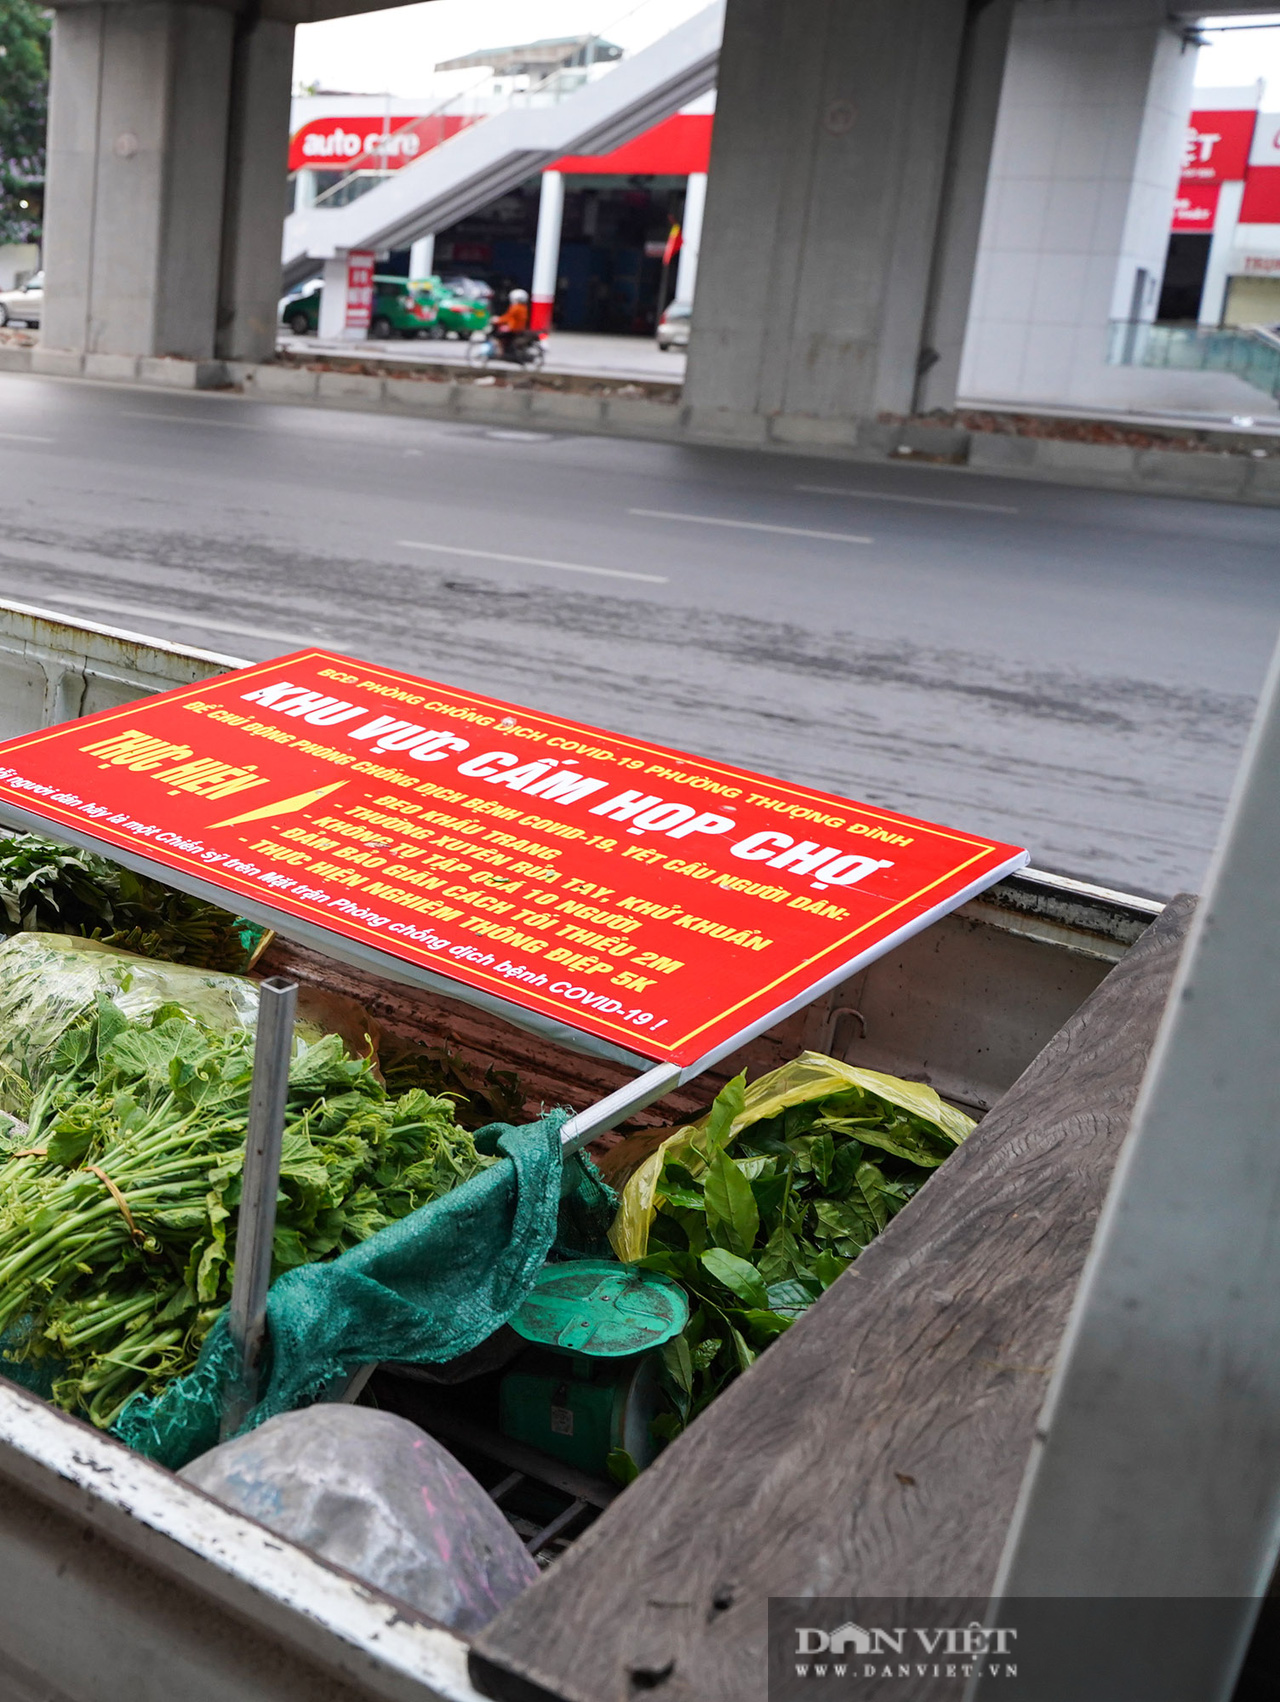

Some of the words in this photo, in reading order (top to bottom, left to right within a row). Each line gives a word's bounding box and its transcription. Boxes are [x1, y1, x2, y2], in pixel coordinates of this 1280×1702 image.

[302, 127, 362, 157] auto
[363, 132, 420, 157] care
[77, 729, 194, 772] THỰC
[149, 756, 271, 801] HIỆN
[181, 700, 225, 714] ĐỂ
[206, 709, 256, 727] CHỦ
[239, 721, 297, 745] ĐỘNG
[287, 739, 357, 766] PHÒNG
[350, 760, 421, 788] CHỐNG
[412, 782, 469, 804] DỊCH
[460, 797, 525, 821] BỆNH
[517, 815, 618, 853] COVID-19,
[620, 845, 669, 865] YÊT
[662, 859, 717, 880] CẦU
[710, 873, 792, 903] NGƯỜI
[786, 895, 851, 921] DÂN:
[239, 681, 389, 726] KHU
[347, 714, 471, 762] VỰC
[456, 751, 610, 806] CẤM
[588, 789, 737, 839] HỌP
[729, 830, 895, 891] CHỢ
[316, 668, 360, 684] BCĐ
[355, 680, 426, 706] PHÒNG
[423, 701, 497, 727] CHỐNG
[492, 720, 549, 742] DỊCH
[545, 736, 645, 770] COVID-19
[643, 764, 743, 799] PHƯỜNG
[744, 792, 847, 829] THƯỢNG
[846, 823, 915, 847] ĐÌNH
[372, 795, 424, 815] ĐEO
[416, 810, 487, 835] KHẨU
[481, 829, 563, 861] TRANG
[4, 776, 61, 796] người
[49, 793, 84, 807] dân
[77, 802, 113, 818] hãy
[105, 813, 131, 825] là
[121, 820, 163, 837] một
[154, 832, 205, 855] Chiến
[200, 848, 231, 863] sỹ
[221, 858, 262, 877] trên
[256, 871, 299, 890] Mặt
[290, 884, 331, 904] trận
[326, 897, 392, 927] Phòng
[388, 922, 452, 951] chống
[448, 945, 496, 966] dịch
[492, 959, 549, 987] bệnh
[548, 981, 654, 1025] COVID-19
[247, 838, 313, 866] THỰC
[303, 860, 371, 890] HIỆN
[360, 881, 465, 922] NGHIÊM
[458, 915, 550, 954] THÔNG
[542, 947, 614, 975] ĐIỆP
[610, 970, 658, 993] 5K
[278, 827, 342, 852] ĐẢM
[331, 843, 401, 869] BẢO
[381, 864, 449, 891] GIÃN
[441, 885, 517, 915] CÁCH
[510, 908, 561, 931] TỐI
[554, 923, 638, 957] THIỂU
[629, 951, 686, 975] 2M
[310, 815, 395, 848] KHÔNG
[388, 842, 428, 859] TỤ
[420, 853, 473, 873] TẬP
[468, 870, 527, 894] QUÁ
[522, 888, 560, 905] 10
[553, 899, 644, 934] NGƯỜI
[344, 805, 436, 841] THƯỜNG
[427, 834, 514, 867] XUYÊN
[505, 860, 563, 884] RỬA
[560, 877, 616, 903] TAY,
[615, 895, 685, 920] KHỬ
[672, 914, 774, 952] KHUẨN
